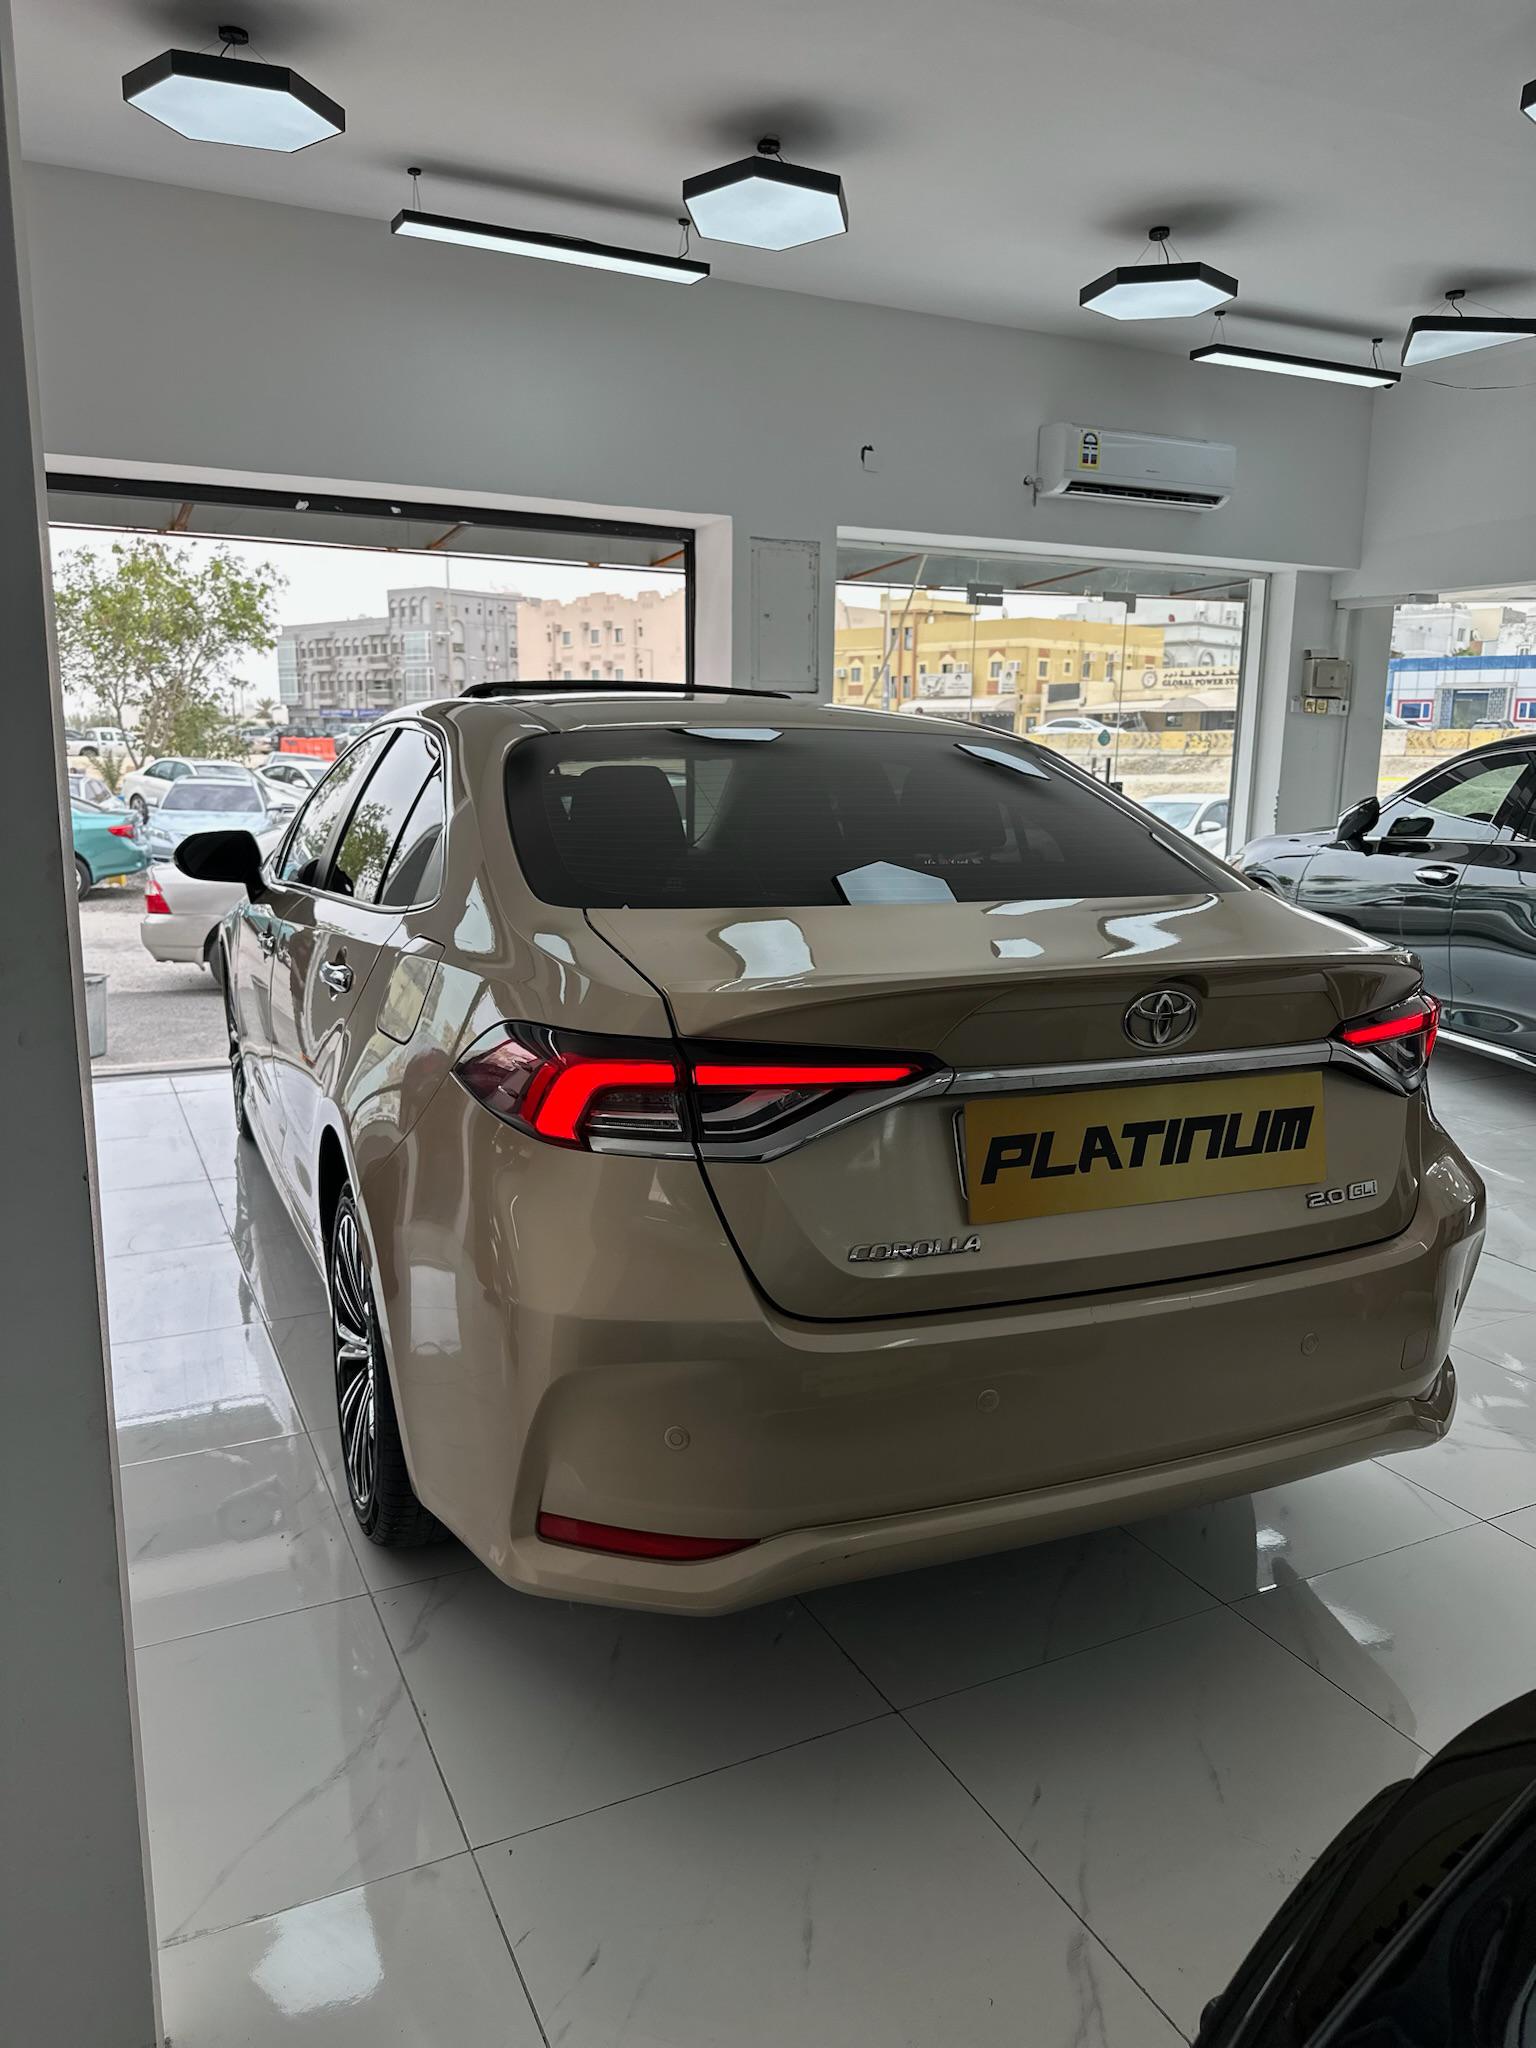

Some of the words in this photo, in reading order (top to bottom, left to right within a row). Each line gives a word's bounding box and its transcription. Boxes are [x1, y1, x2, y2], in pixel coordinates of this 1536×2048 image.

[1162, 679, 1193, 687] GLOBAL
[1195, 678, 1223, 686] POWER
[981, 1106, 1315, 1185] PLATINUM
[848, 1234, 981, 1262] COROLLA
